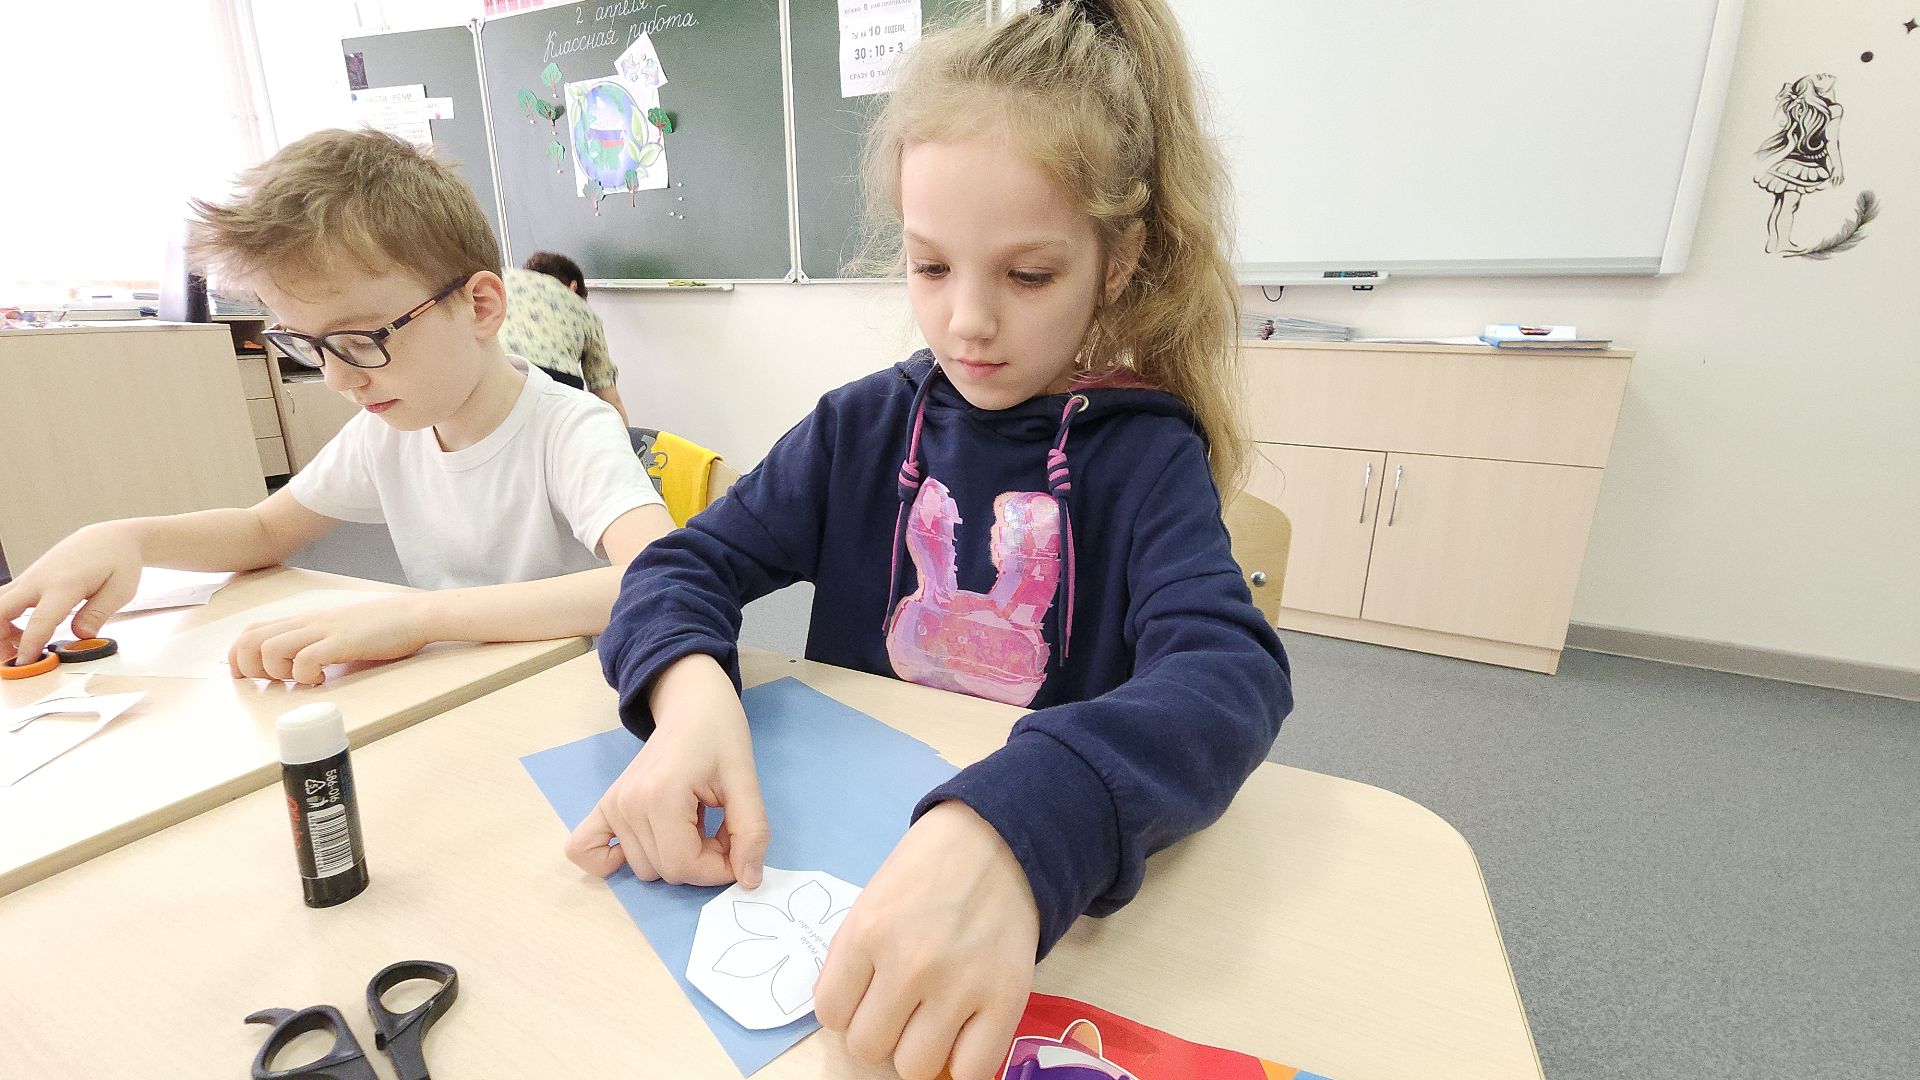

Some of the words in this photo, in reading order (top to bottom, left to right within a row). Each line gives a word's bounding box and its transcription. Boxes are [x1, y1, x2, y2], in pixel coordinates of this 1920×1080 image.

[575, 7, 584, 25] 2
[868, 25, 881, 37] 10
[543, 30, 618, 63] Классная
[854, 47, 866, 60] 30
[875, 44, 885, 57] 10
[897, 41, 904, 54] 3
[849, 72, 868, 81] СРАЗУ
